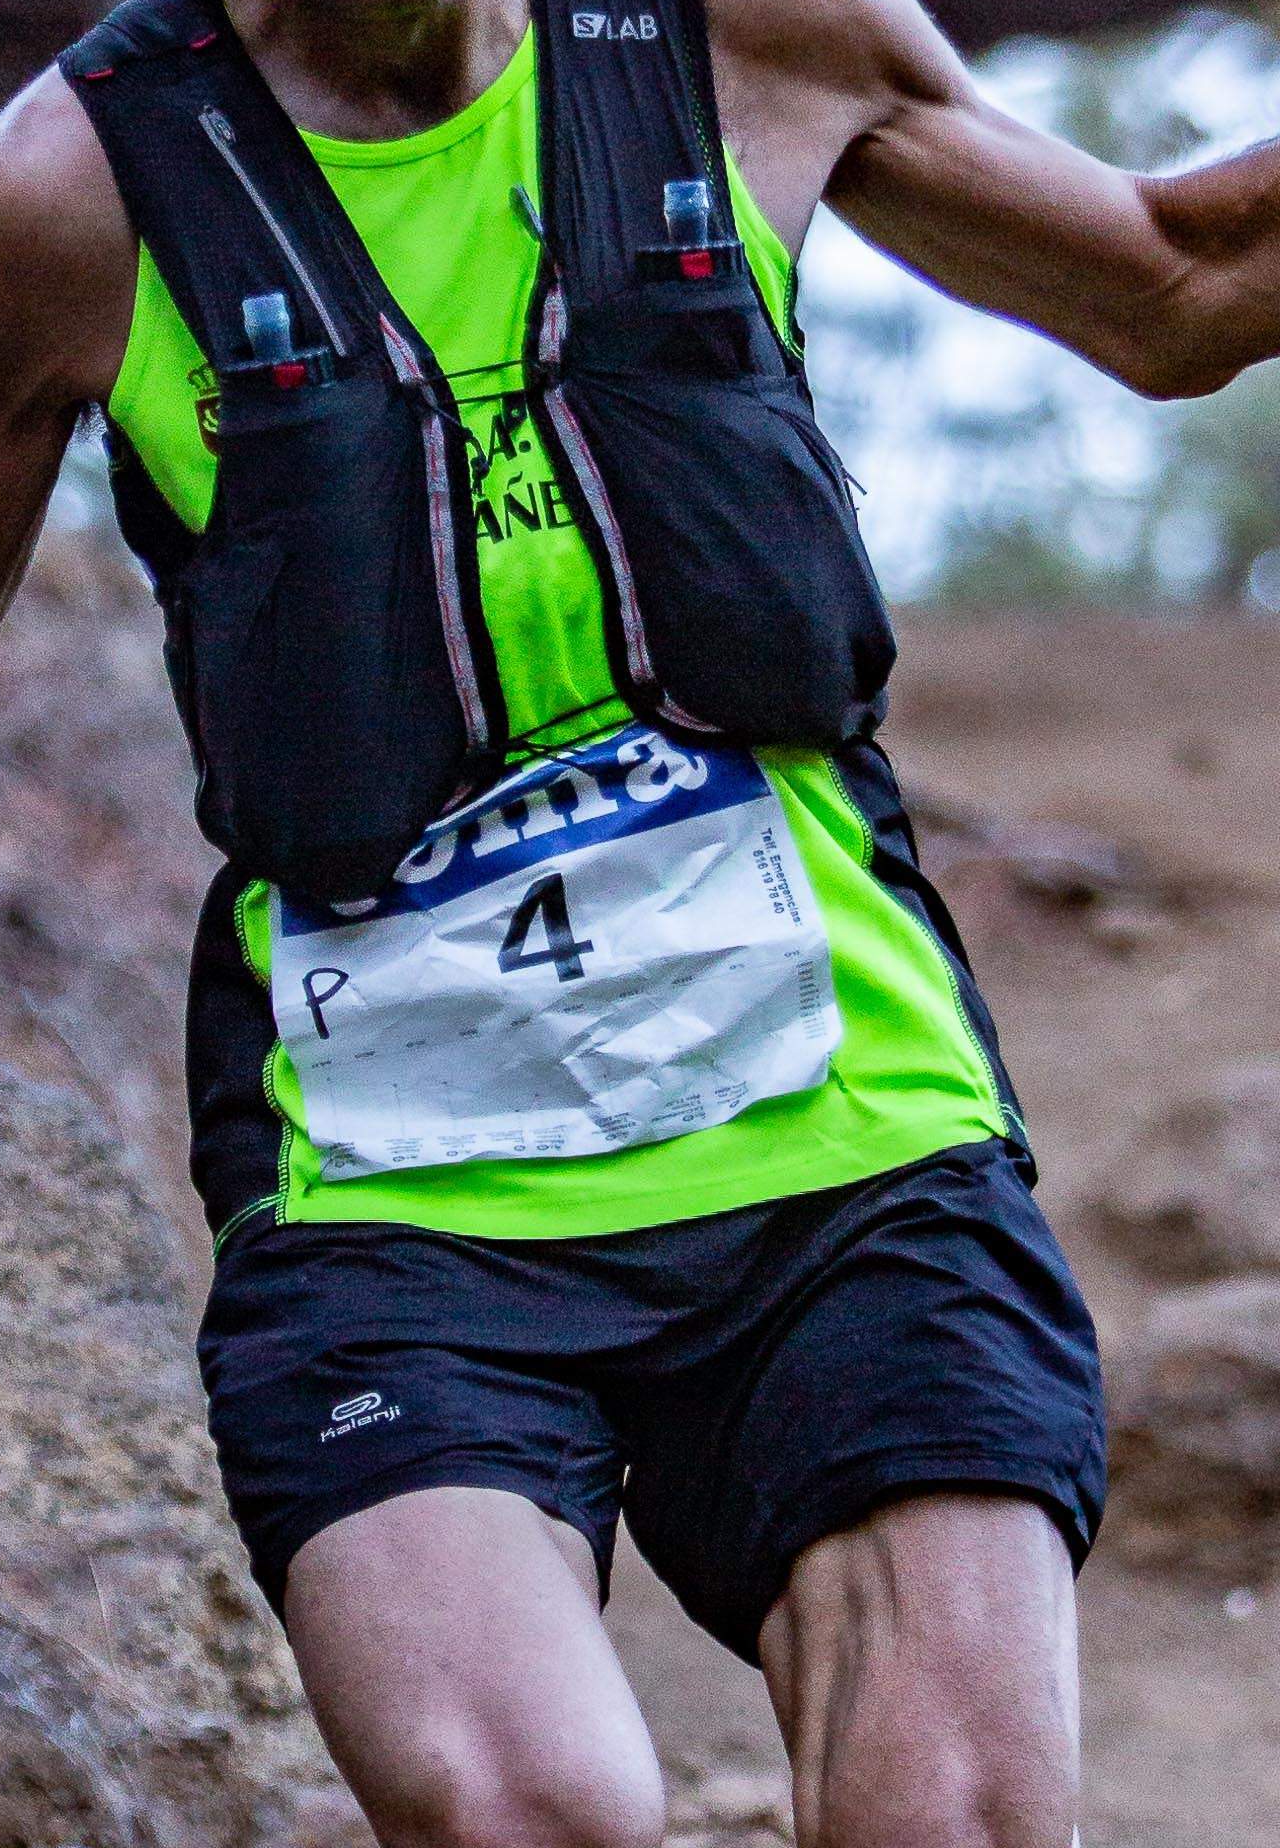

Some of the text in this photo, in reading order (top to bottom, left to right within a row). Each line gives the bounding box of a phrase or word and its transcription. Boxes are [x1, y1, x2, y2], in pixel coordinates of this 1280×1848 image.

[330, 731, 710, 917] oma
[498, 872, 594, 983] 4
[300, 966, 350, 1040] P
